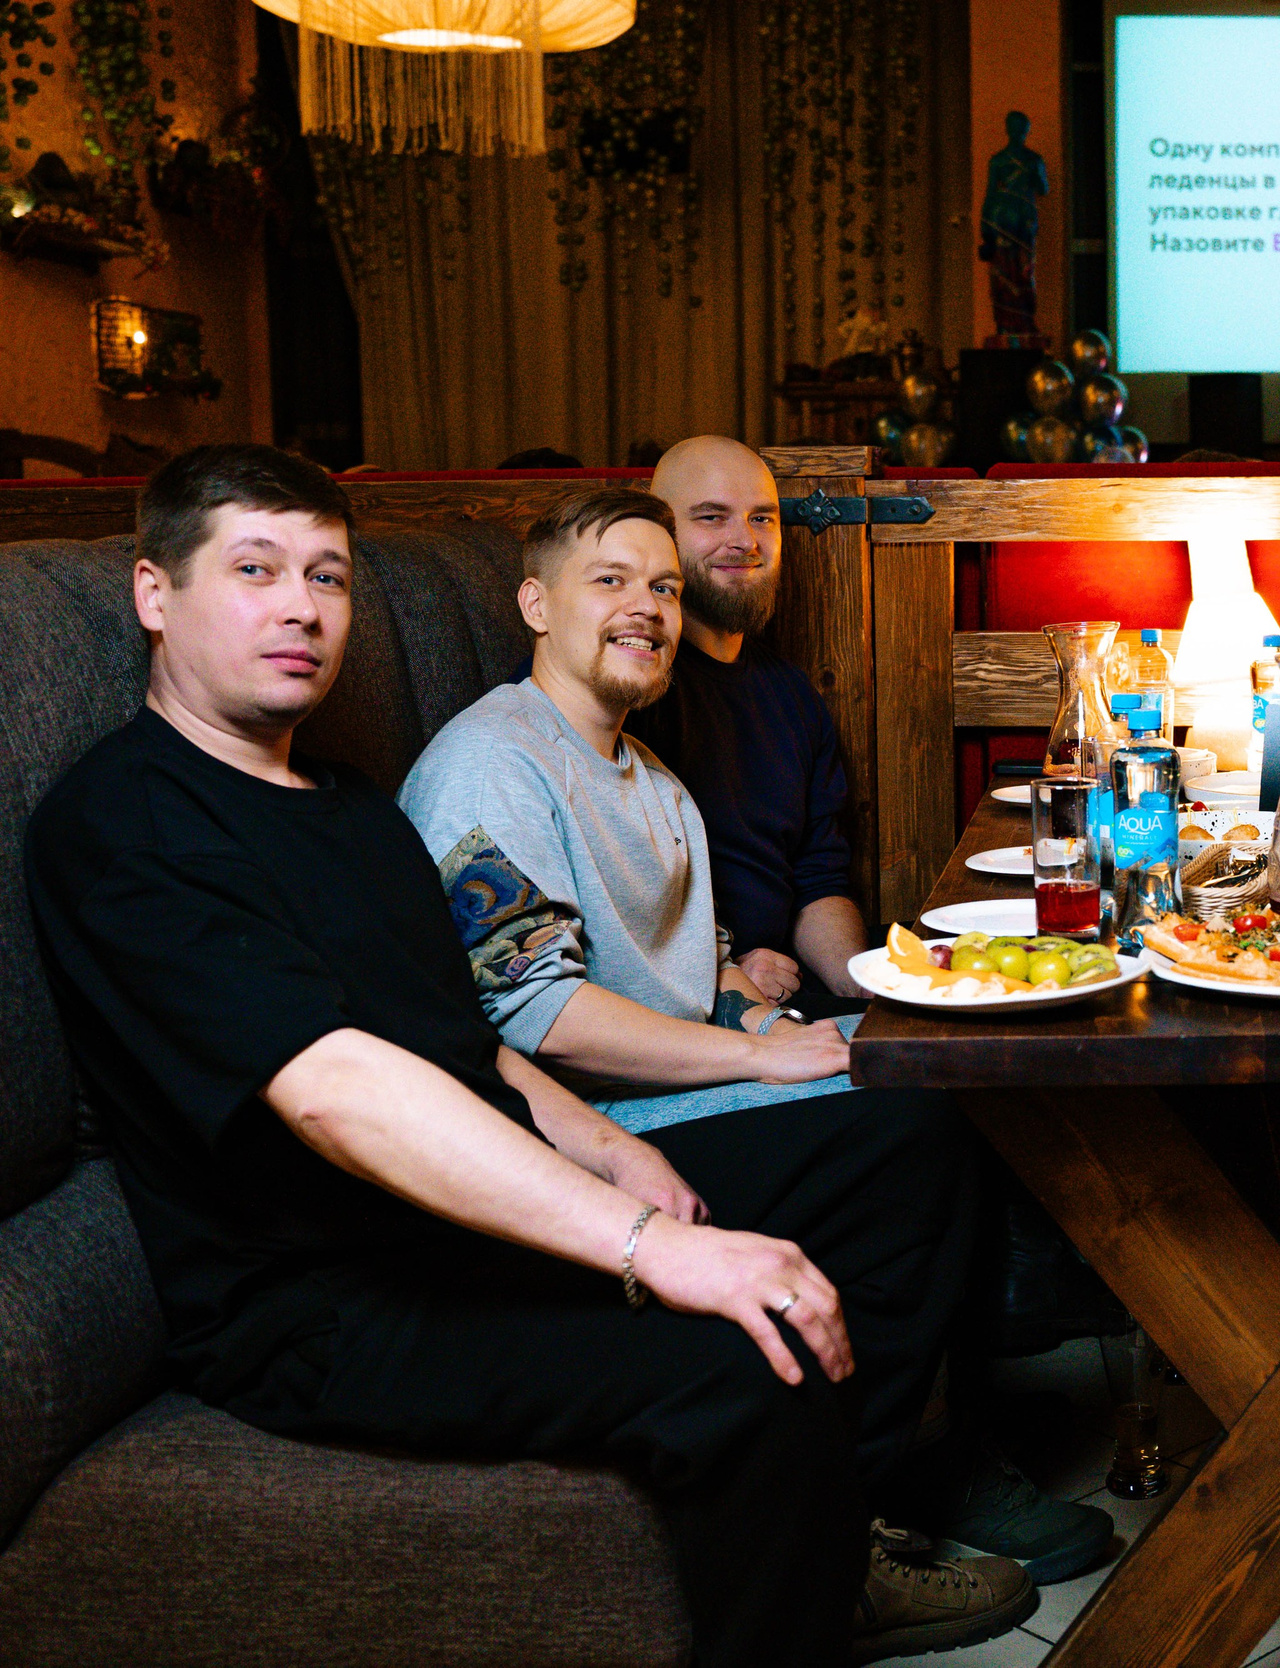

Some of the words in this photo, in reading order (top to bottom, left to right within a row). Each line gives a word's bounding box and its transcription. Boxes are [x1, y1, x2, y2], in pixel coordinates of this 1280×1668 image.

[1149, 137, 1214, 163] Одну
[1148, 172, 1257, 191] леденцы
[1263, 174, 1275, 189] в
[1149, 205, 1262, 225] упаковке
[1150, 231, 1265, 253] Назовите
[1118, 814, 1163, 836] AQUA
